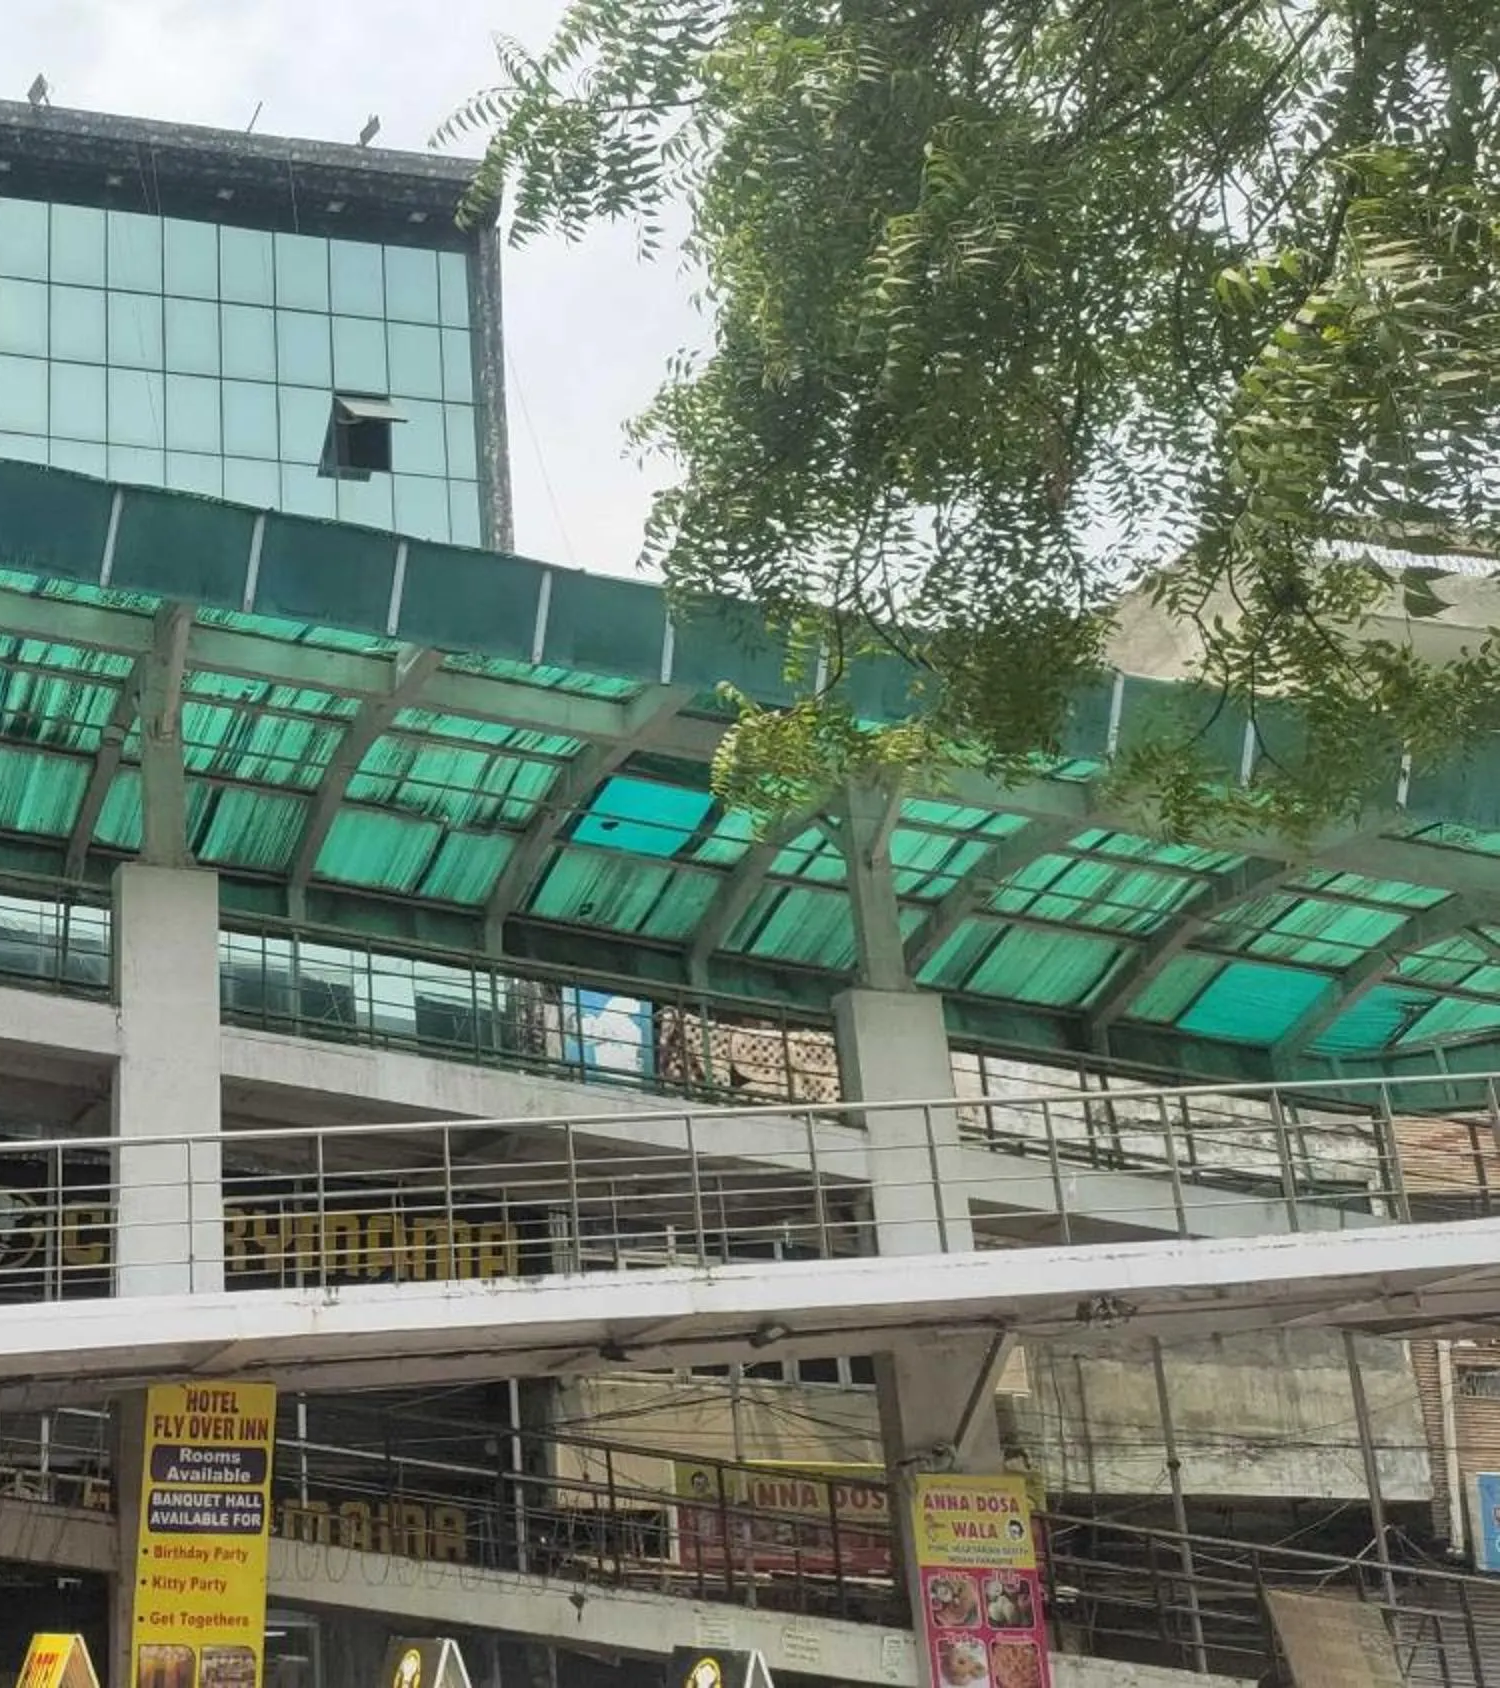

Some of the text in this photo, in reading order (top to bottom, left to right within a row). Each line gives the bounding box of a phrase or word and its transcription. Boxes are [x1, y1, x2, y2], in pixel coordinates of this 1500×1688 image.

[186, 1389, 238, 1413] HOTEL
[153, 1415, 268, 1440] FLY OVER INN
[180, 1448, 241, 1464] Rooms
[167, 1466, 251, 1483] Available
[152, 1492, 261, 1508] BANQUET HALL
[835, 1487, 885, 1510] DOS
[924, 1493, 1020, 1513] ANNA DOSA
[150, 1511, 261, 1526] AVAILABLE FOR
[951, 1521, 998, 1539] WALA
[153, 1545, 248, 1563] Birthday Party
[152, 1576, 227, 1594] Kitty Party
[150, 1611, 249, 1628] Get Togethers
